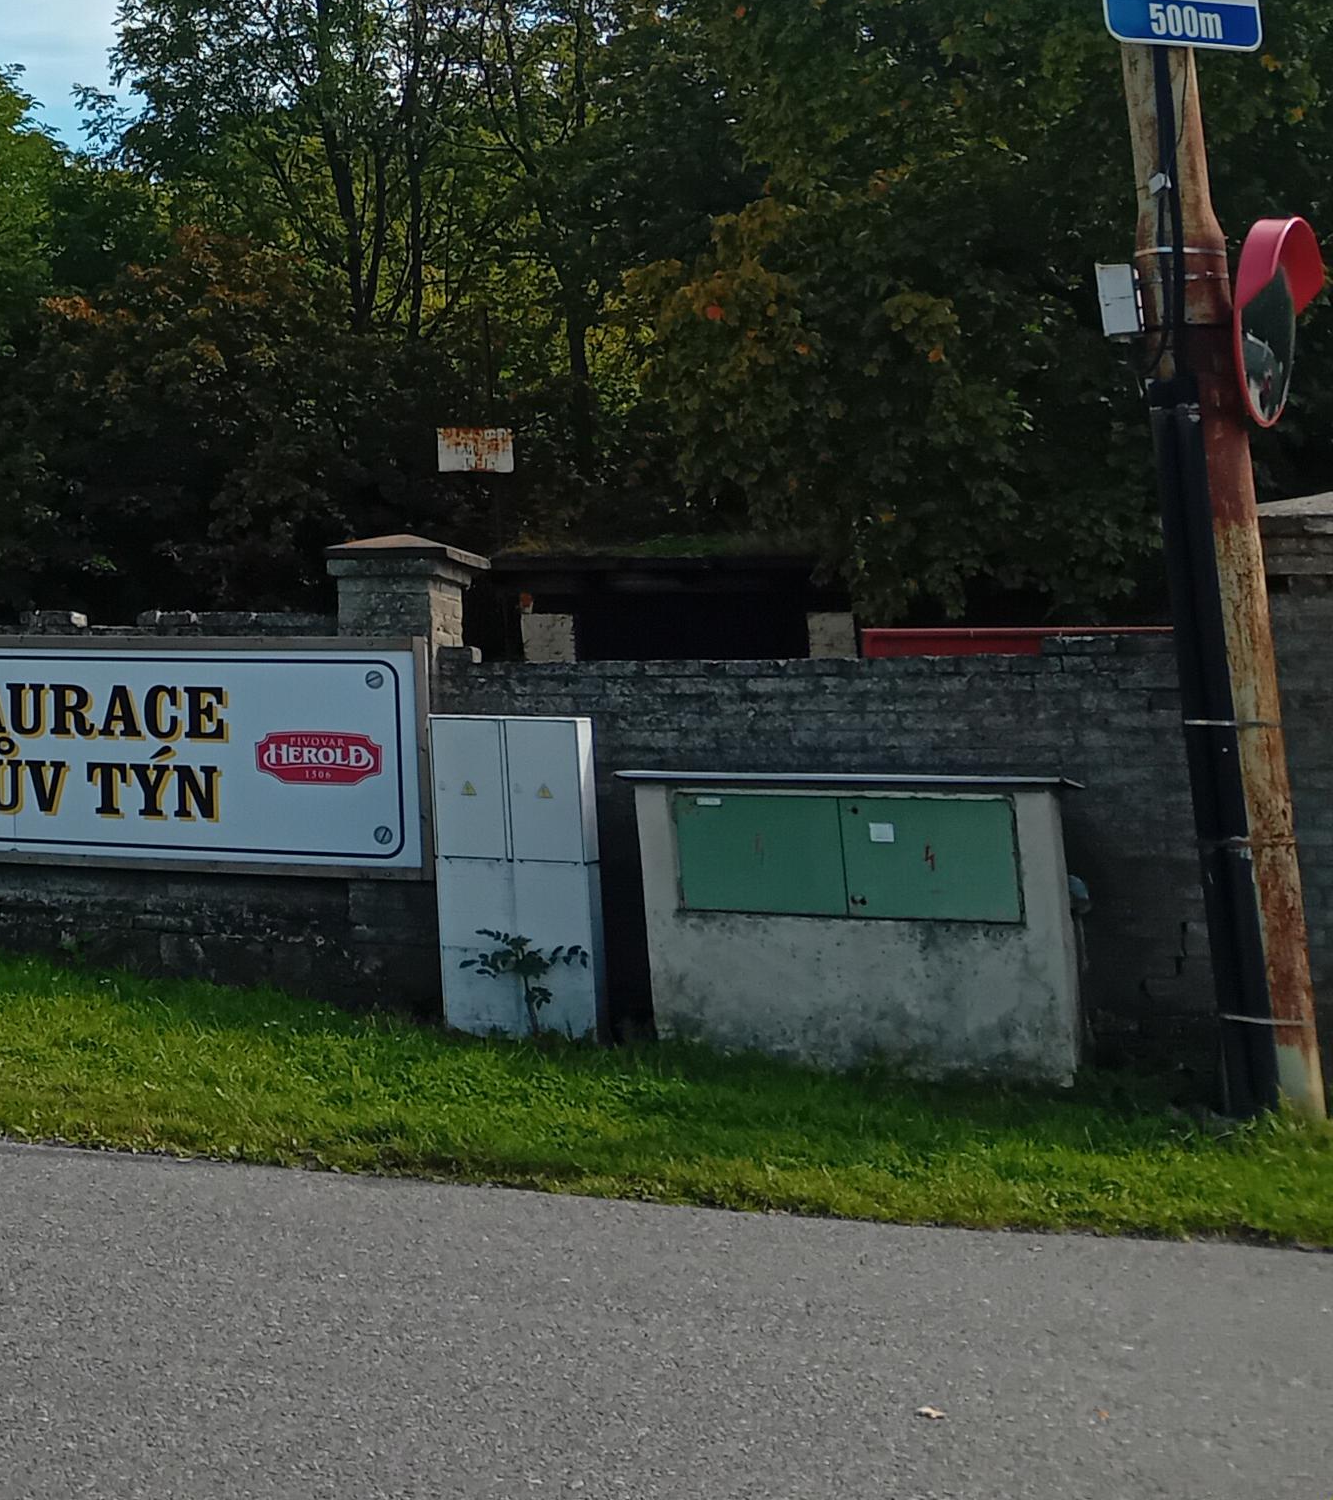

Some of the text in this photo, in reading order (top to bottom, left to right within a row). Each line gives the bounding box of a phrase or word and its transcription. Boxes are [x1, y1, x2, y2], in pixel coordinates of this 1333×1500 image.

[1148, 2, 1224, 40] 500m
[263, 743, 374, 770] HEROLD
[289, 736, 345, 747] PIVOVAR
[86, 746, 223, 823] TÝN
